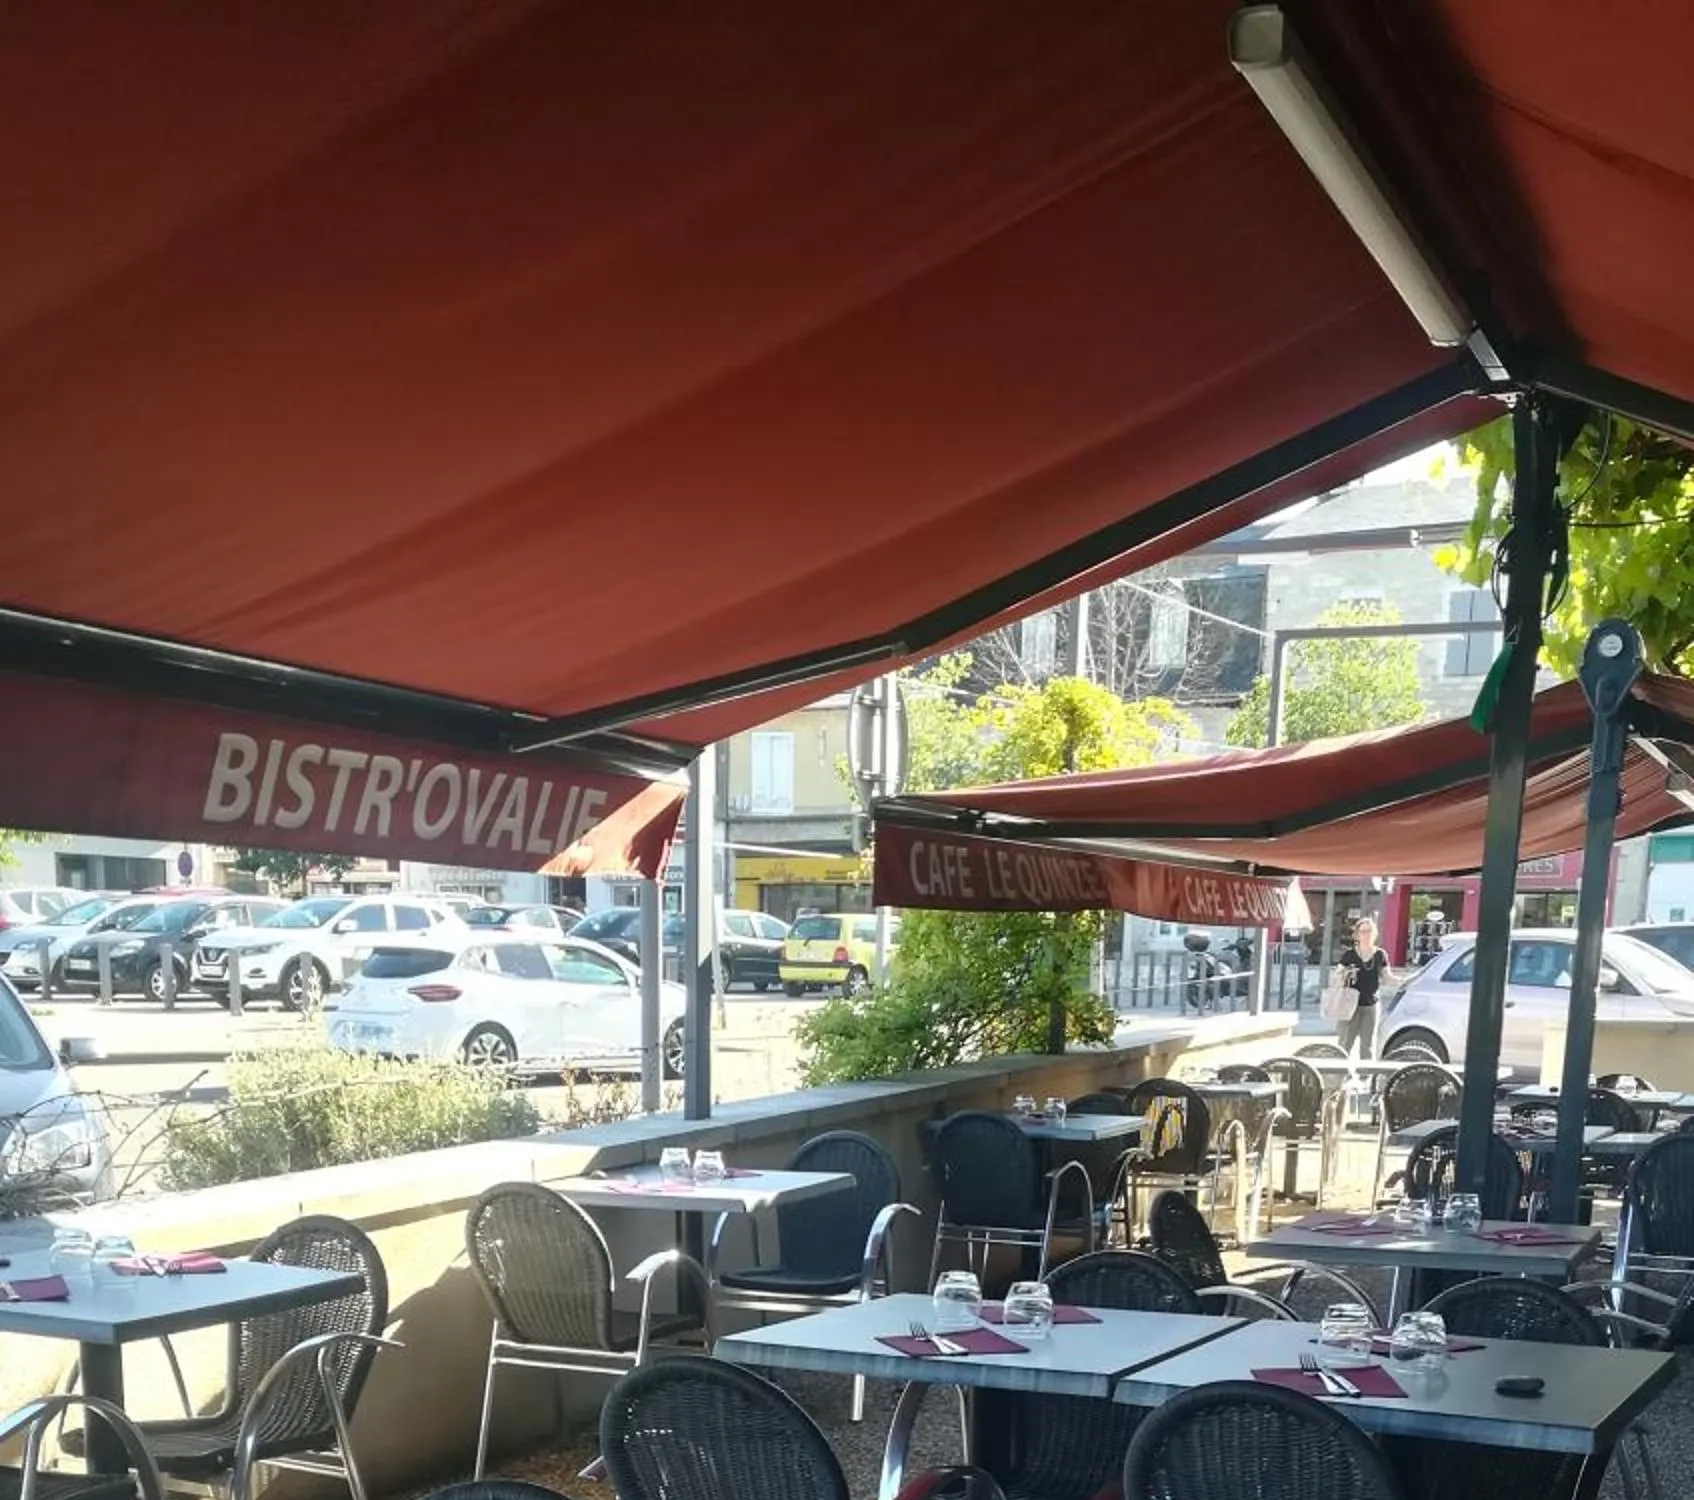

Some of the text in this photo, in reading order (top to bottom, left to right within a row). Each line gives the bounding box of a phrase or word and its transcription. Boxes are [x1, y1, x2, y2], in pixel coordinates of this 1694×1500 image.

[203, 732, 608, 854] BISTR'OVALIE
[910, 841, 974, 898] CAFE
[1184, 876, 1224, 916] CAFE
